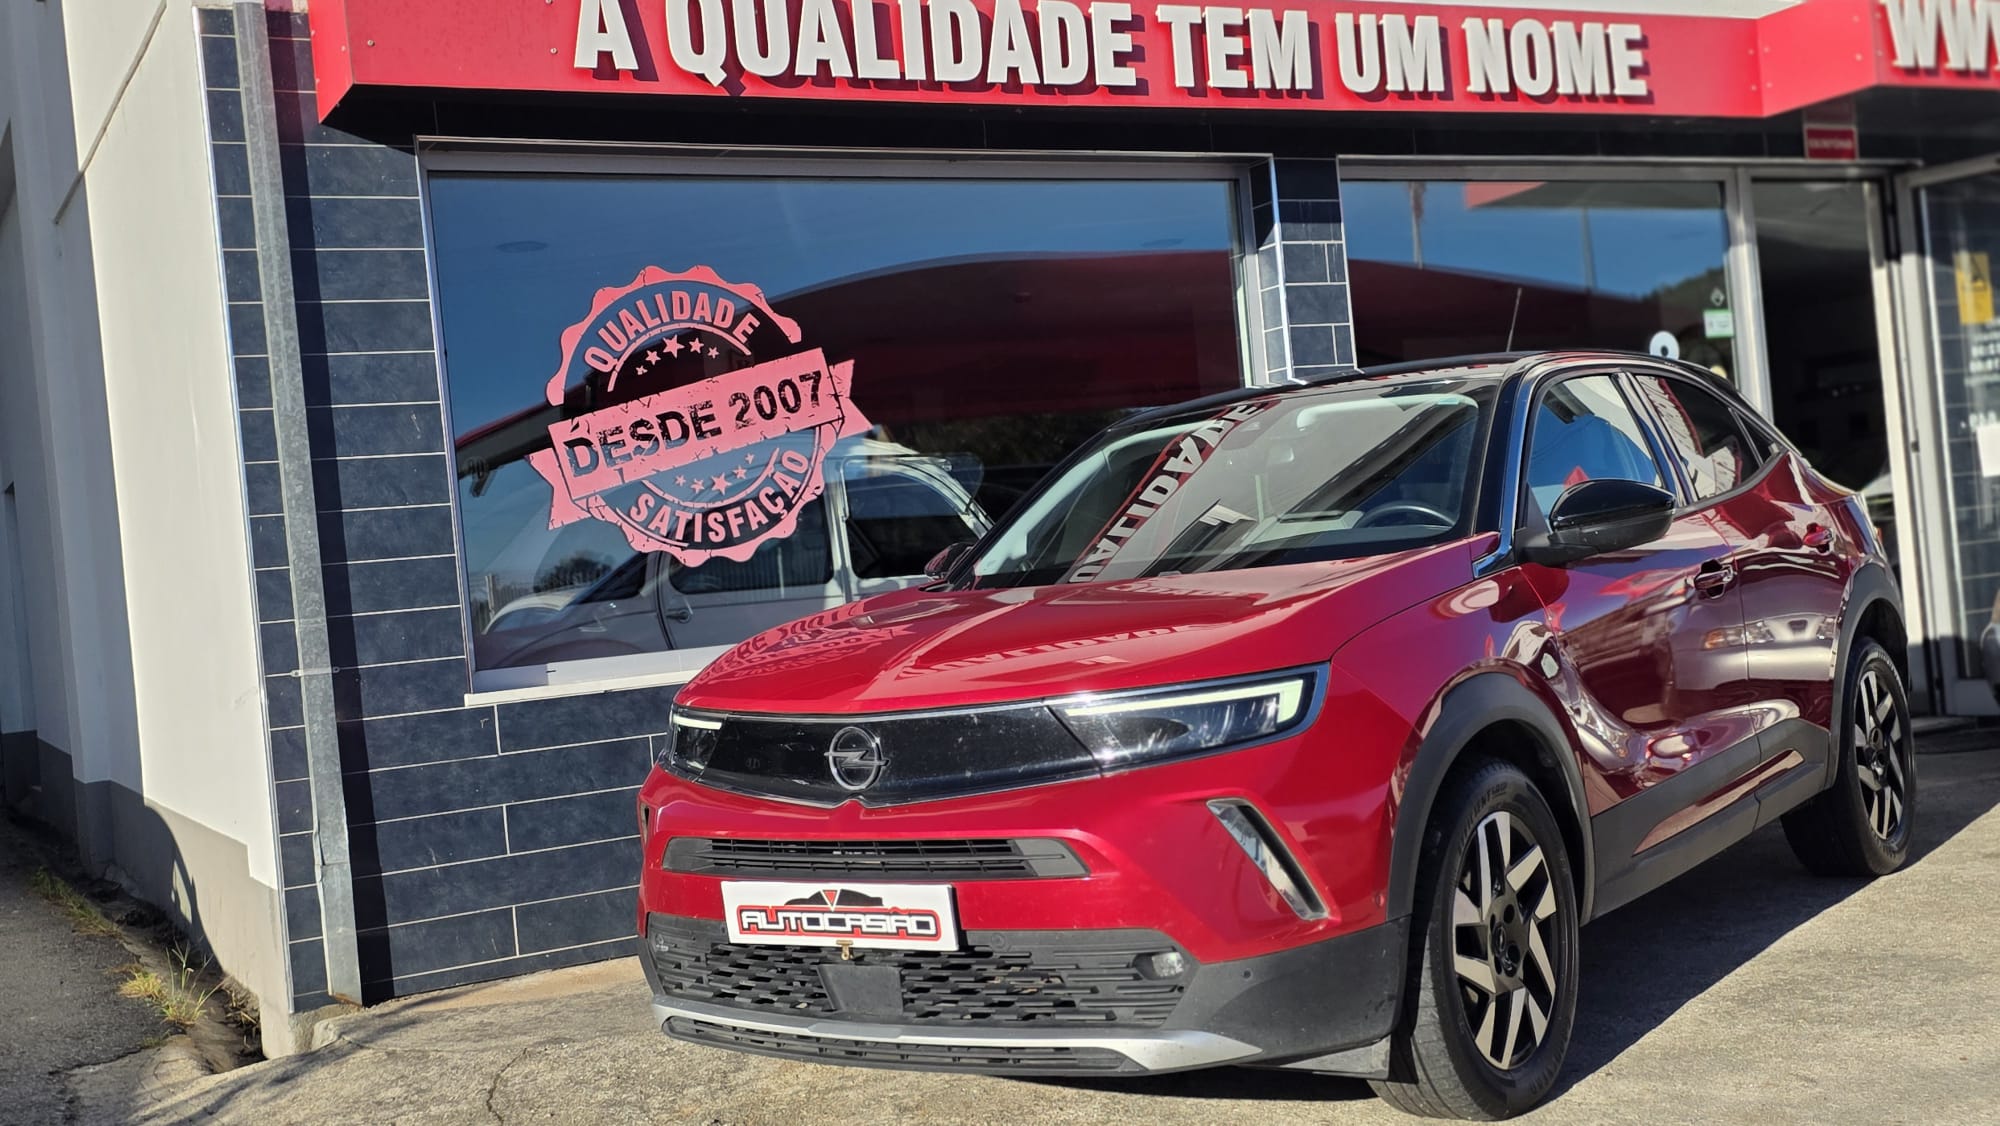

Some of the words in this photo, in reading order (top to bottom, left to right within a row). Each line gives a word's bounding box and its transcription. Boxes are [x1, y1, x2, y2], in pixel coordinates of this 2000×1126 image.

[574, 0, 639, 70] A
[665, 0, 1136, 88] QUALIDADE
[1158, 6, 1312, 91] TEM
[1334, 12, 1445, 93] UM
[1462, 17, 1648, 96] NOME
[584, 290, 760, 373] QUALIDADE
[562, 400, 723, 478] DESDE
[728, 370, 823, 431] 2007
[629, 449, 809, 543] SATISFAÇÃO
